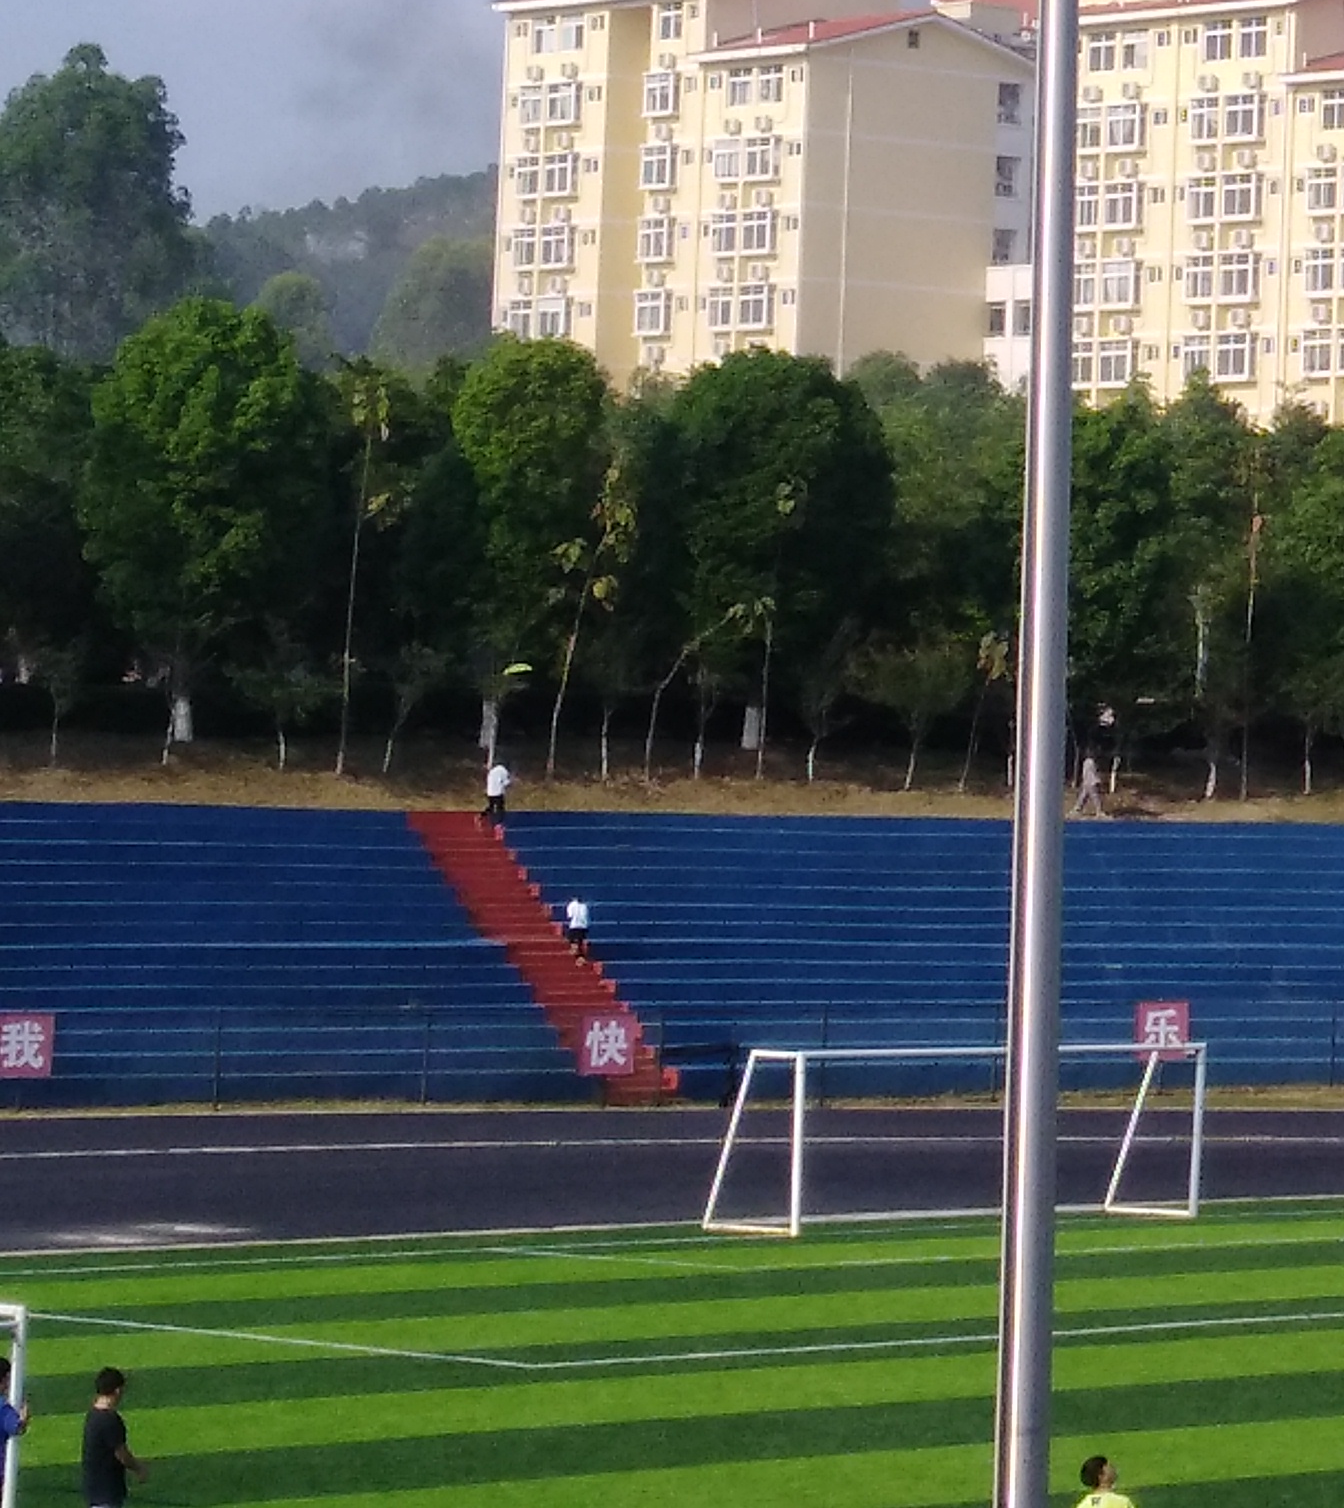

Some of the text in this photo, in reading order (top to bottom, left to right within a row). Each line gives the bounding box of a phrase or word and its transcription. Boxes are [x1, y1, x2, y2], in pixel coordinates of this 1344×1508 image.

[0, 1020, 45, 1069] 我
[585, 1020, 628, 1068] 快
[1144, 1009, 1183, 1048] 乐
